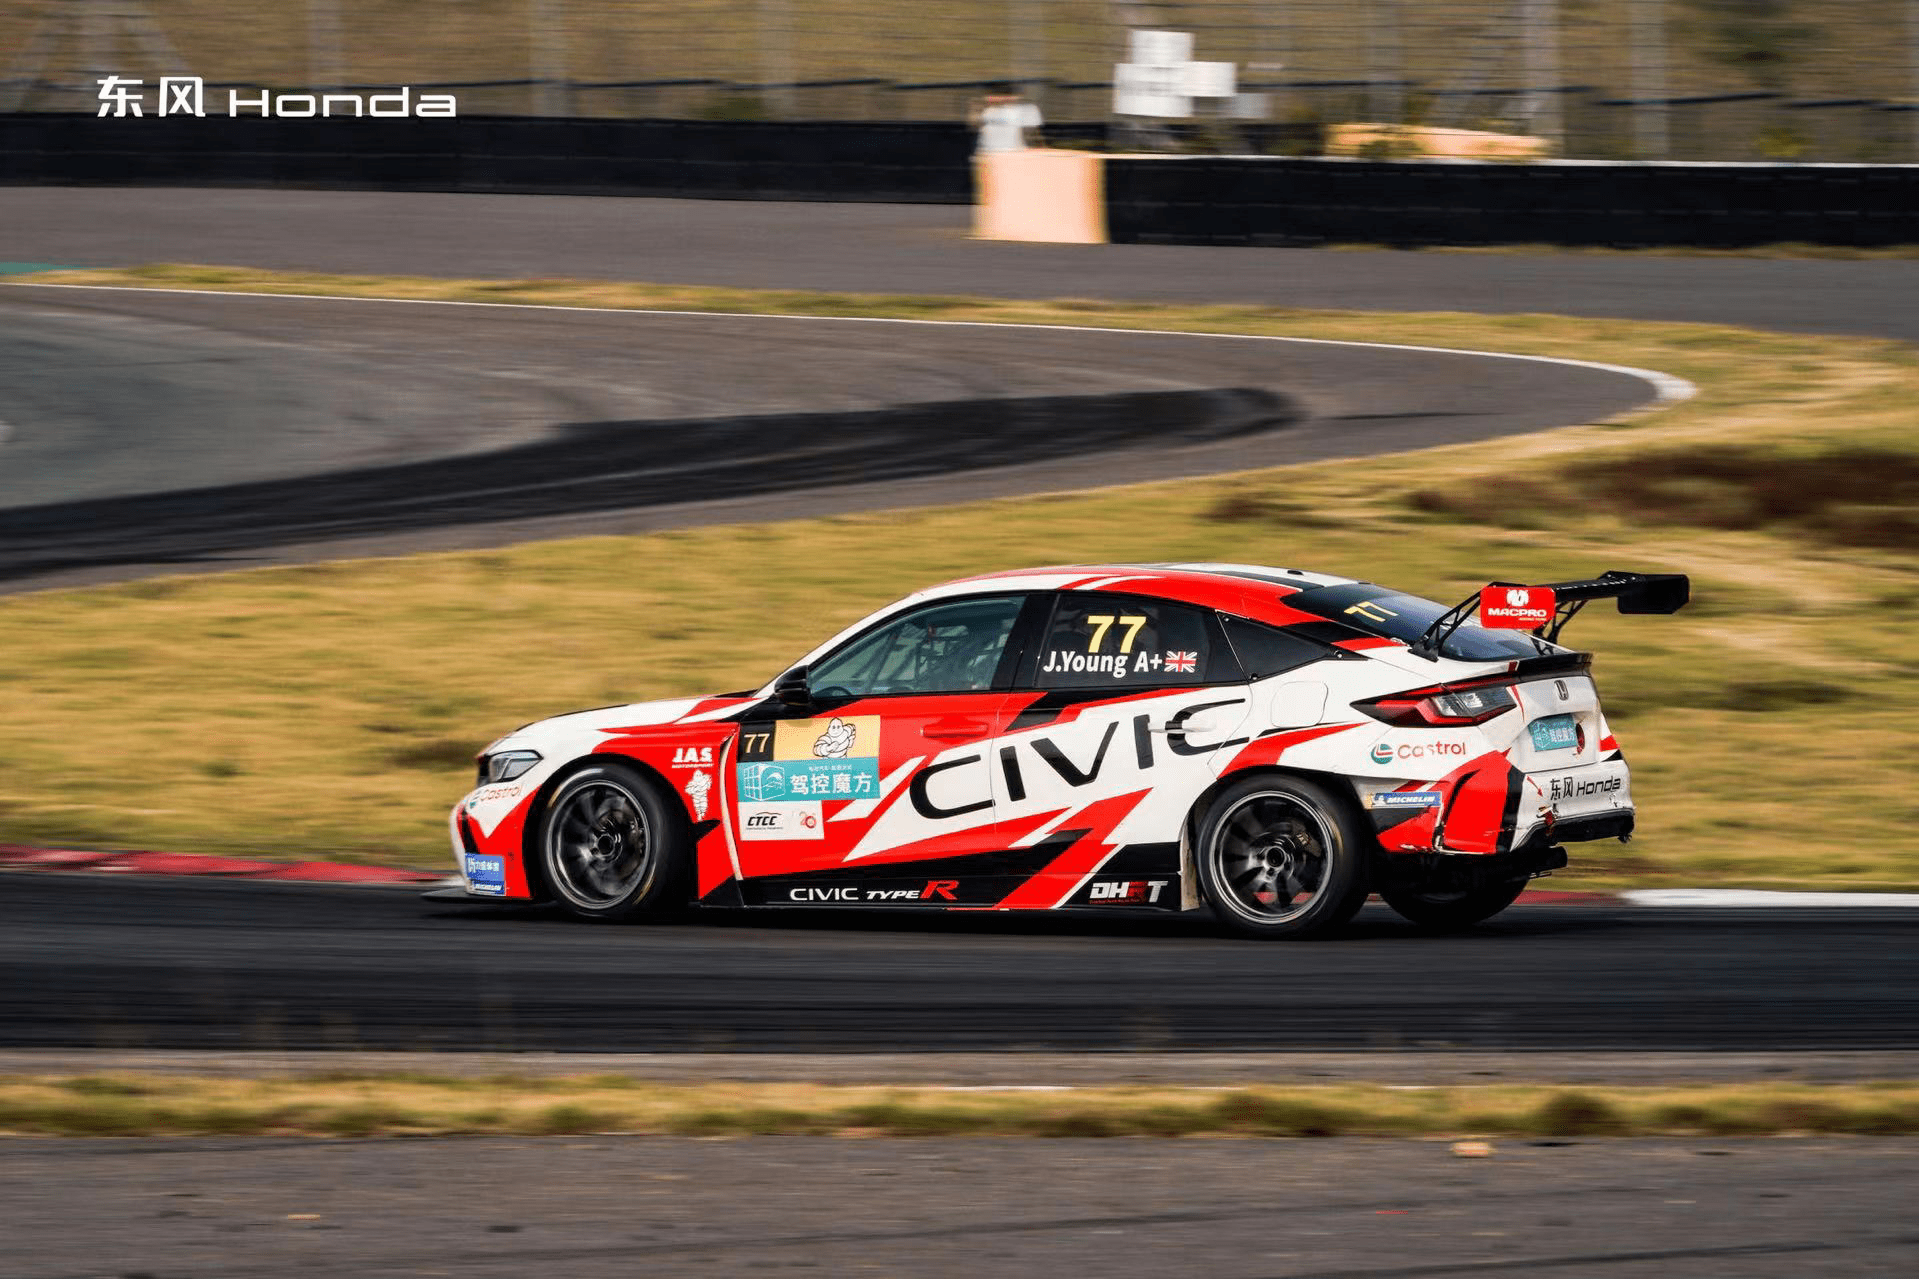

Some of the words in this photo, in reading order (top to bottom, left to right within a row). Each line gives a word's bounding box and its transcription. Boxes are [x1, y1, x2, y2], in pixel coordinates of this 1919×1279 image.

[1344, 601, 1399, 622] 77
[1488, 607, 1547, 617] MACPRO
[1087, 615, 1147, 654] 77
[1043, 650, 1128, 678] J.Young
[1134, 651, 1162, 672] A+
[744, 733, 770, 753] 77
[1398, 741, 1466, 759] Castrol
[672, 747, 713, 762] JAS
[909, 698, 1250, 819] CIVIC
[790, 772, 873, 795] 驾控魔方
[1550, 777, 1573, 800] 东风
[1576, 776, 1621, 797] Honda
[1386, 796, 1435, 804] MICHELIN
[748, 816, 778, 826] CTCC
[789, 888, 859, 900] CIVIC
[866, 890, 920, 899] TYPE
[920, 880, 959, 900] R
